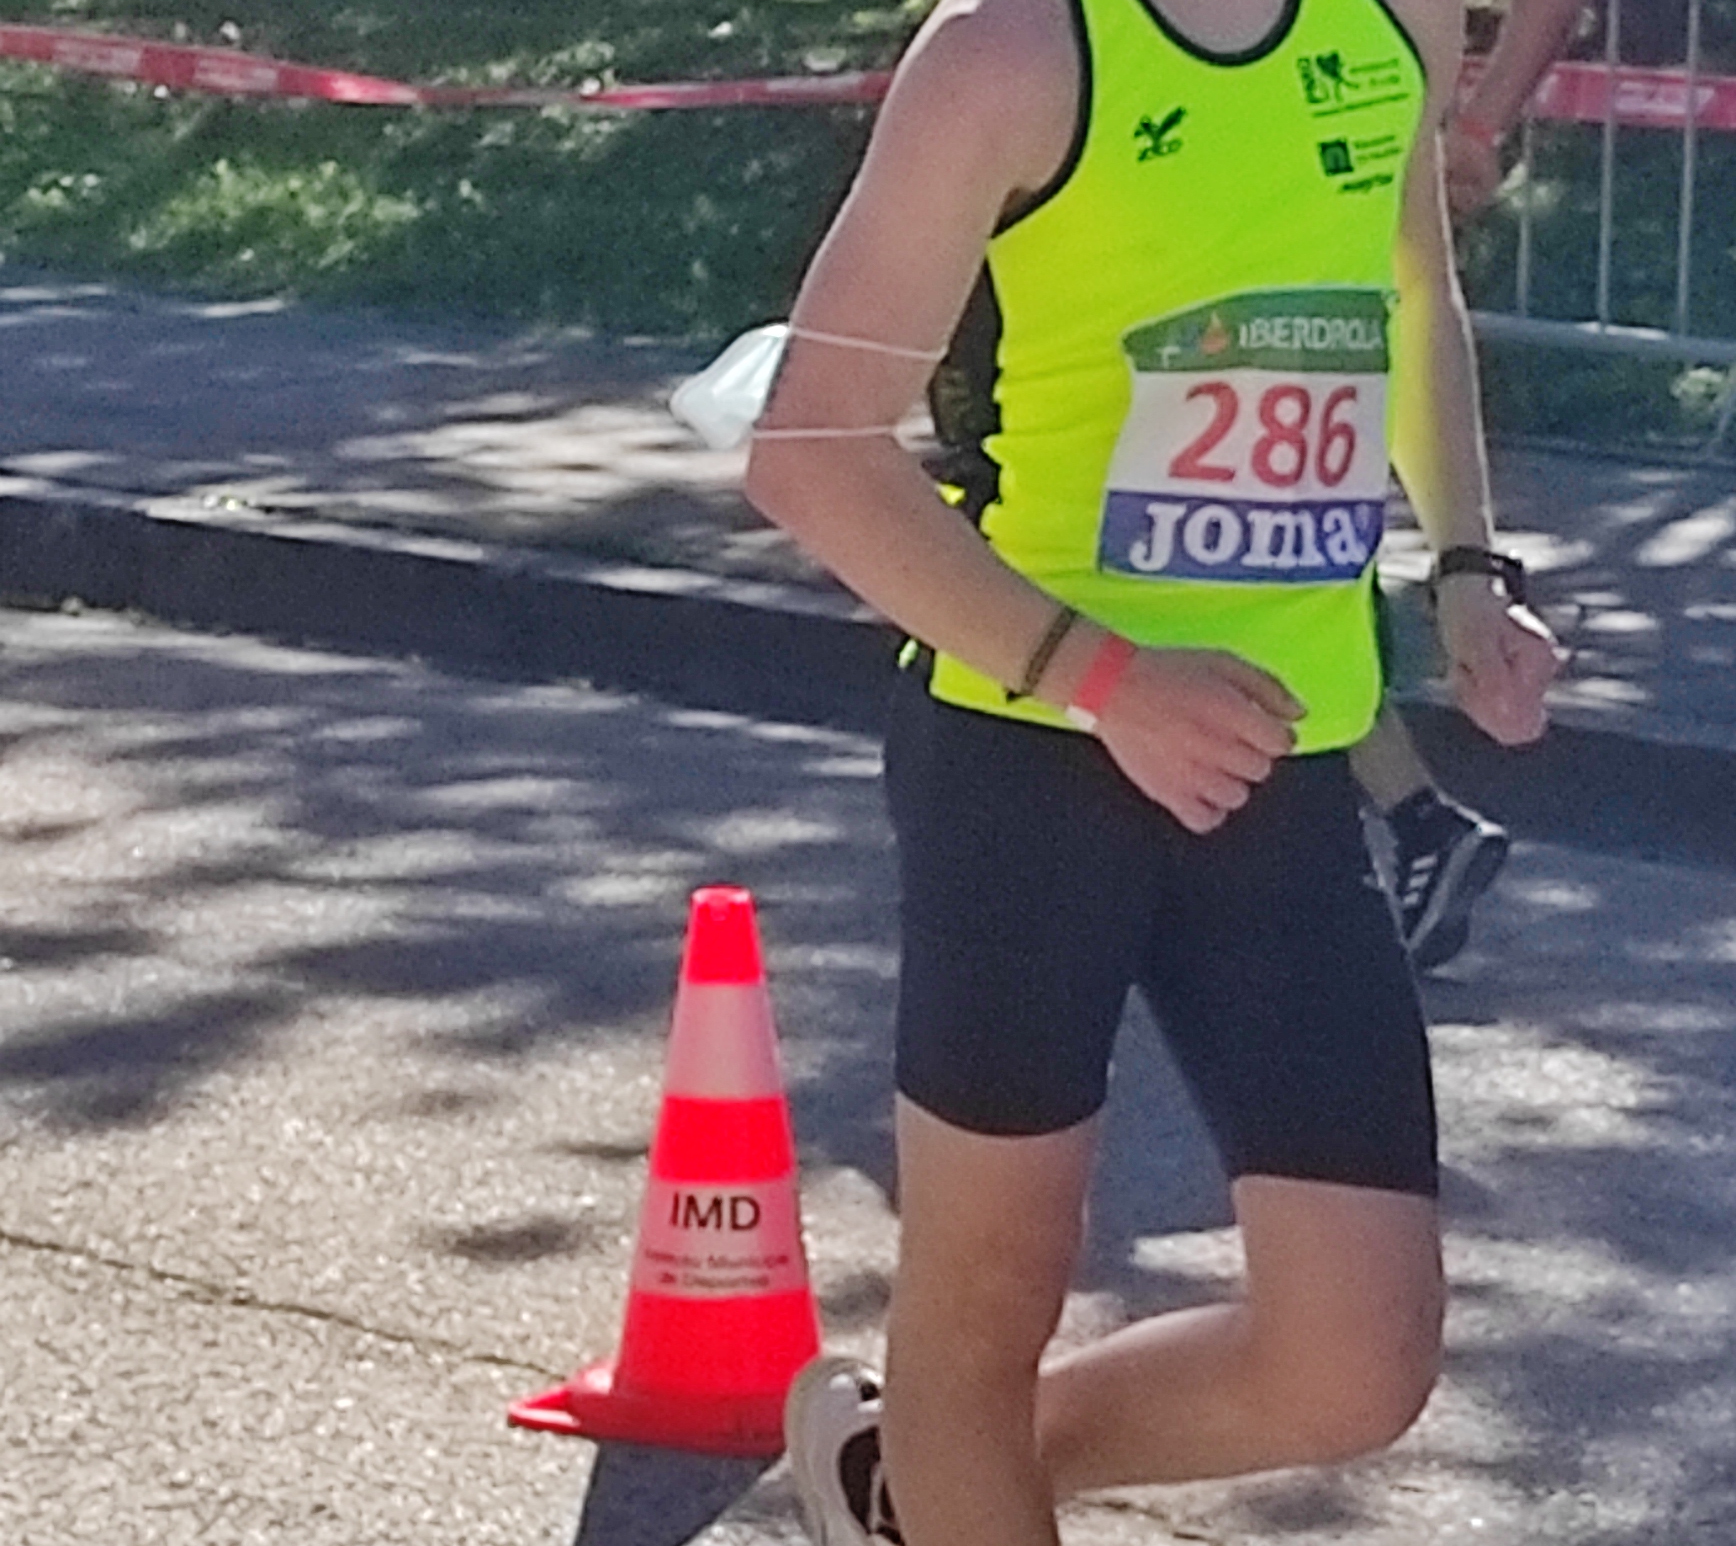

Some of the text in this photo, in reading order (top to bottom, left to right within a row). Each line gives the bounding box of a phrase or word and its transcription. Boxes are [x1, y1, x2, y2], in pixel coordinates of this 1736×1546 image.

[1238, 315, 1384, 351] IBERDROLA
[1168, 381, 1358, 488] 286
[669, 1192, 761, 1232] IMD
